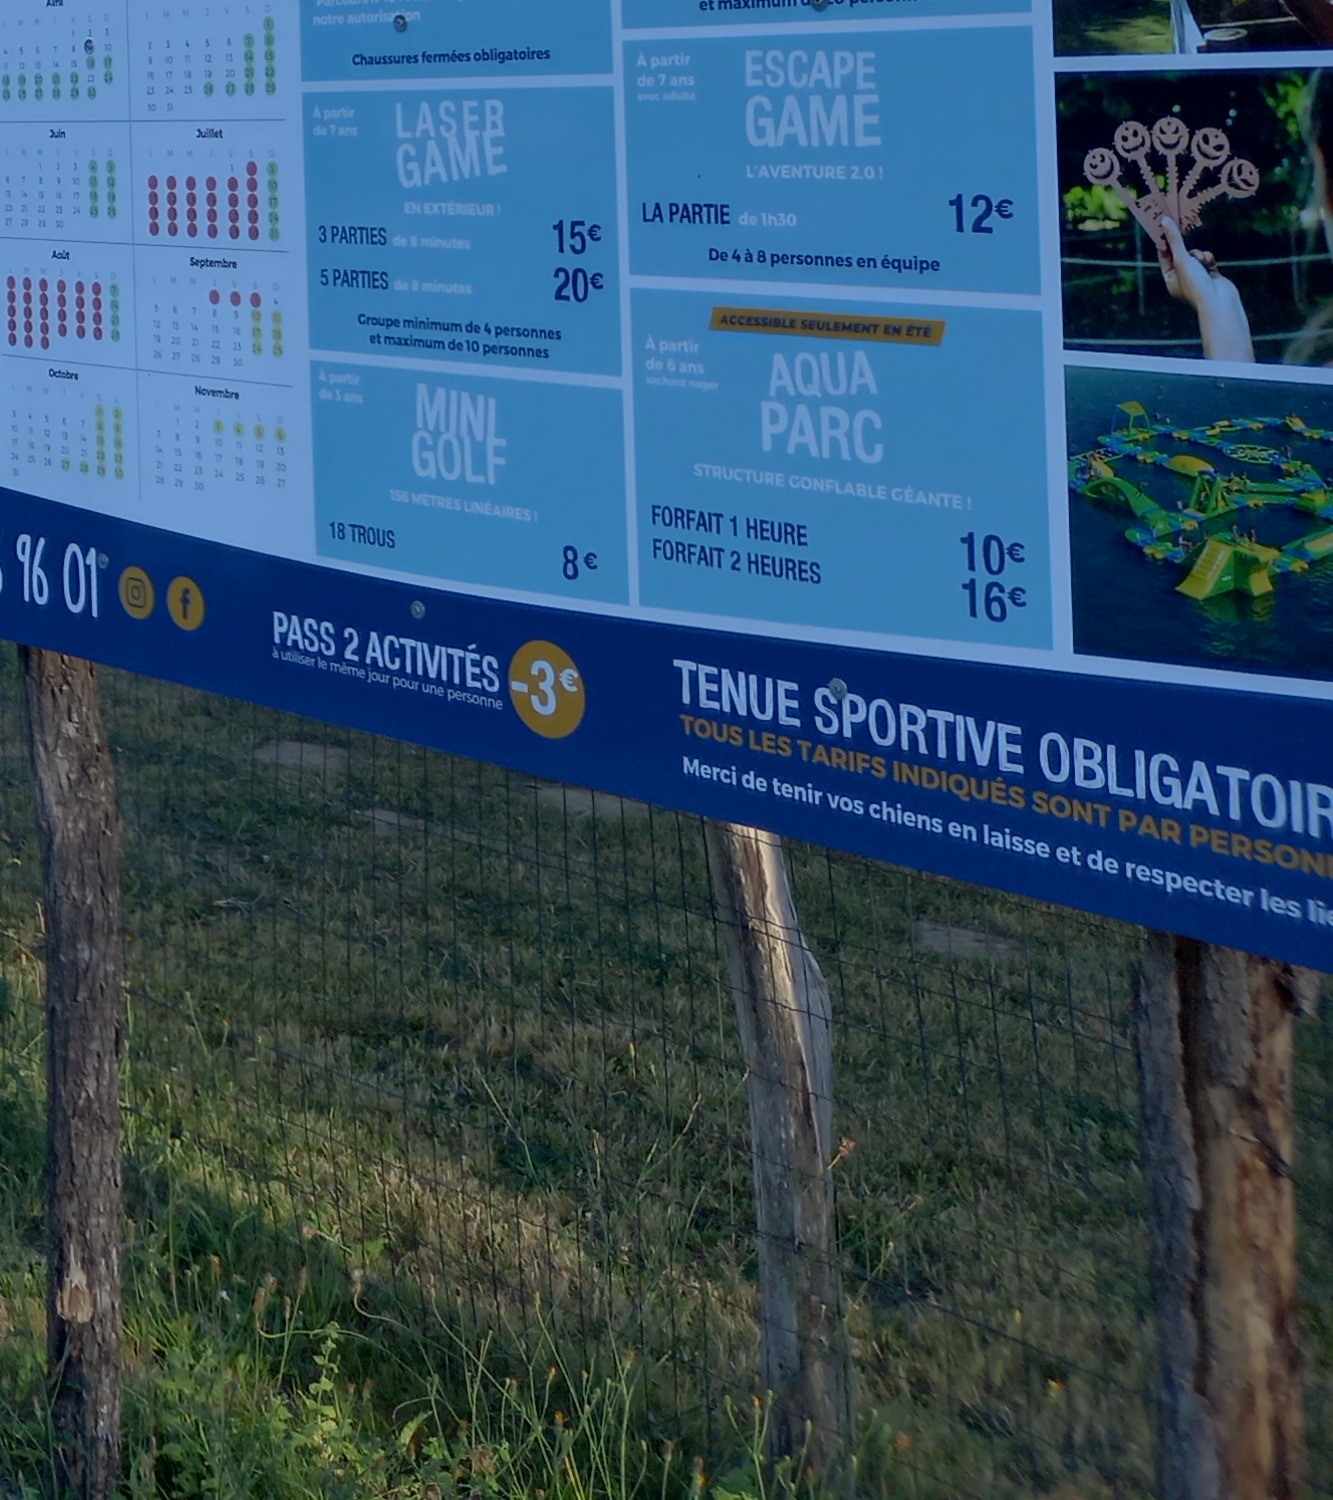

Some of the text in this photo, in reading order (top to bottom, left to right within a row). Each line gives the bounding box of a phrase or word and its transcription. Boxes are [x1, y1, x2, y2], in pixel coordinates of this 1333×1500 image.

[352, 48, 550, 65] Chaussures fermées obligatoires
[745, 50, 876, 90] ESCAPE
[196, 129, 223, 139] Juillet
[396, 99, 505, 138] LASER
[746, 94, 881, 148] GAME
[396, 130, 507, 188] GAME
[746, 165, 846, 180] L'AVENTURE
[642, 202, 796, 227] LA PARTIE de 1h30
[949, 193, 1013, 234] 12€
[319, 226, 386, 245] 3 PARTIES
[553, 220, 601, 254] 15€
[190, 257, 237, 270] Septembre
[320, 269, 389, 289] 5 PARTIES
[708, 248, 940, 273] De personnes en équipe
[554, 267, 603, 302] 20€
[358, 314, 562, 340] Groupe minimum de personnes
[719, 314, 879, 335] ACCESSIBLE SEULEMENT
[369, 333, 549, 359] et maximum de personnes
[49, 369, 79, 381] Octobre
[195, 386, 239, 400] Novembre
[769, 350, 878, 397] AQUA
[416, 383, 497, 441] MINI
[760, 401, 883, 464] PARC
[412, 430, 506, 484] GOLF
[694, 464, 886, 500] STRUCTURE GONFLABLE
[330, 522, 395, 548] 18 TROUS
[652, 504, 808, 547] FORFAIT HEURE
[653, 539, 821, 584] FORFAIT 2 HEURES
[960, 532, 1025, 575] 10€
[16, 534, 48, 605] 96
[63, 543, 98, 618] 01
[961, 577, 1026, 623] 16€
[273, 611, 335, 656] PASS
[344, 627, 359, 661] 2
[365, 631, 500, 692] ACTIVITÉS
[281, 650, 503, 709] utiliser même pour une personne
[673, 659, 801, 728] TENUE
[814, 687, 1024, 774] SPORTIVE
[680, 714, 743, 746] TOUS
[749, 730, 791, 757] LES
[797, 740, 887, 778] TARIFS
[893, 760, 1025, 809] INDIQUÉS
[1033, 790, 1110, 827] SONT
[1119, 810, 1181, 844] PAR
[683, 756, 1302, 918] Merci de tenir vos chiens en laisse et de respecter les
